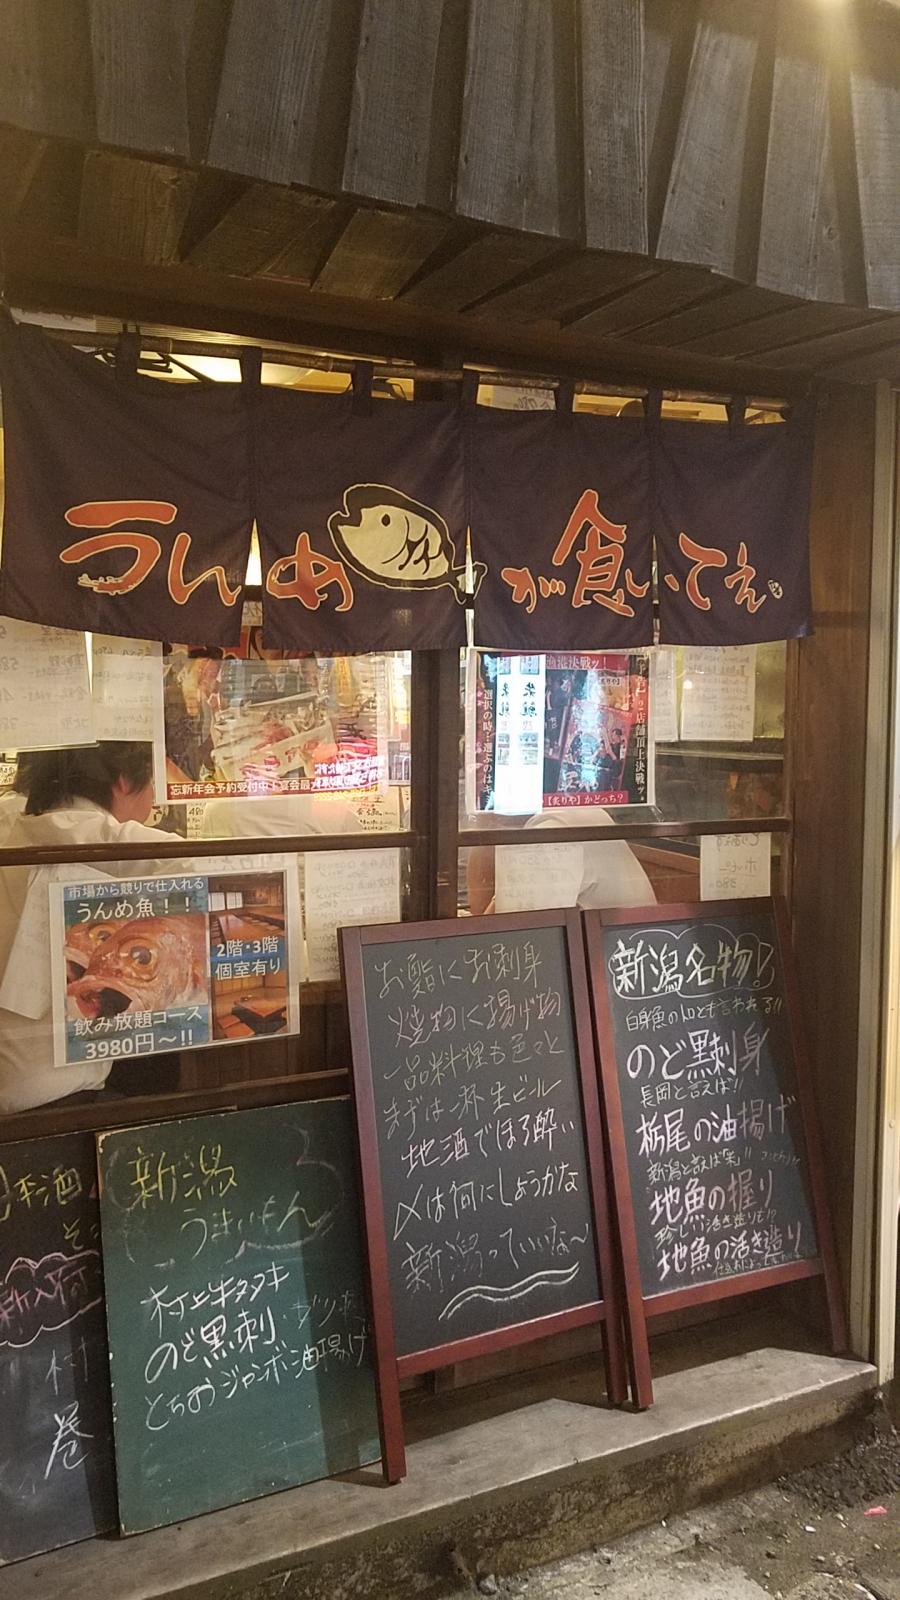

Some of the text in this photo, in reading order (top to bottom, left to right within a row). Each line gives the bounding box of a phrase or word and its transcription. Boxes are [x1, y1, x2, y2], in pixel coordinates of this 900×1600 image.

[68, 877, 205, 899] 市場から競りで仕入れる
[215, 959, 282, 981] 個室有り
[73, 1006, 203, 1037] 飲み放題コース
[627, 1021, 770, 1081] のど黒刺身
[635, 1093, 797, 1158] 栃尾の油揚げ
[130, 1145, 238, 1210] 新潟
[649, 1168, 773, 1226] 地魚の握り
[656, 1220, 802, 1282] 地魚の活き造り
